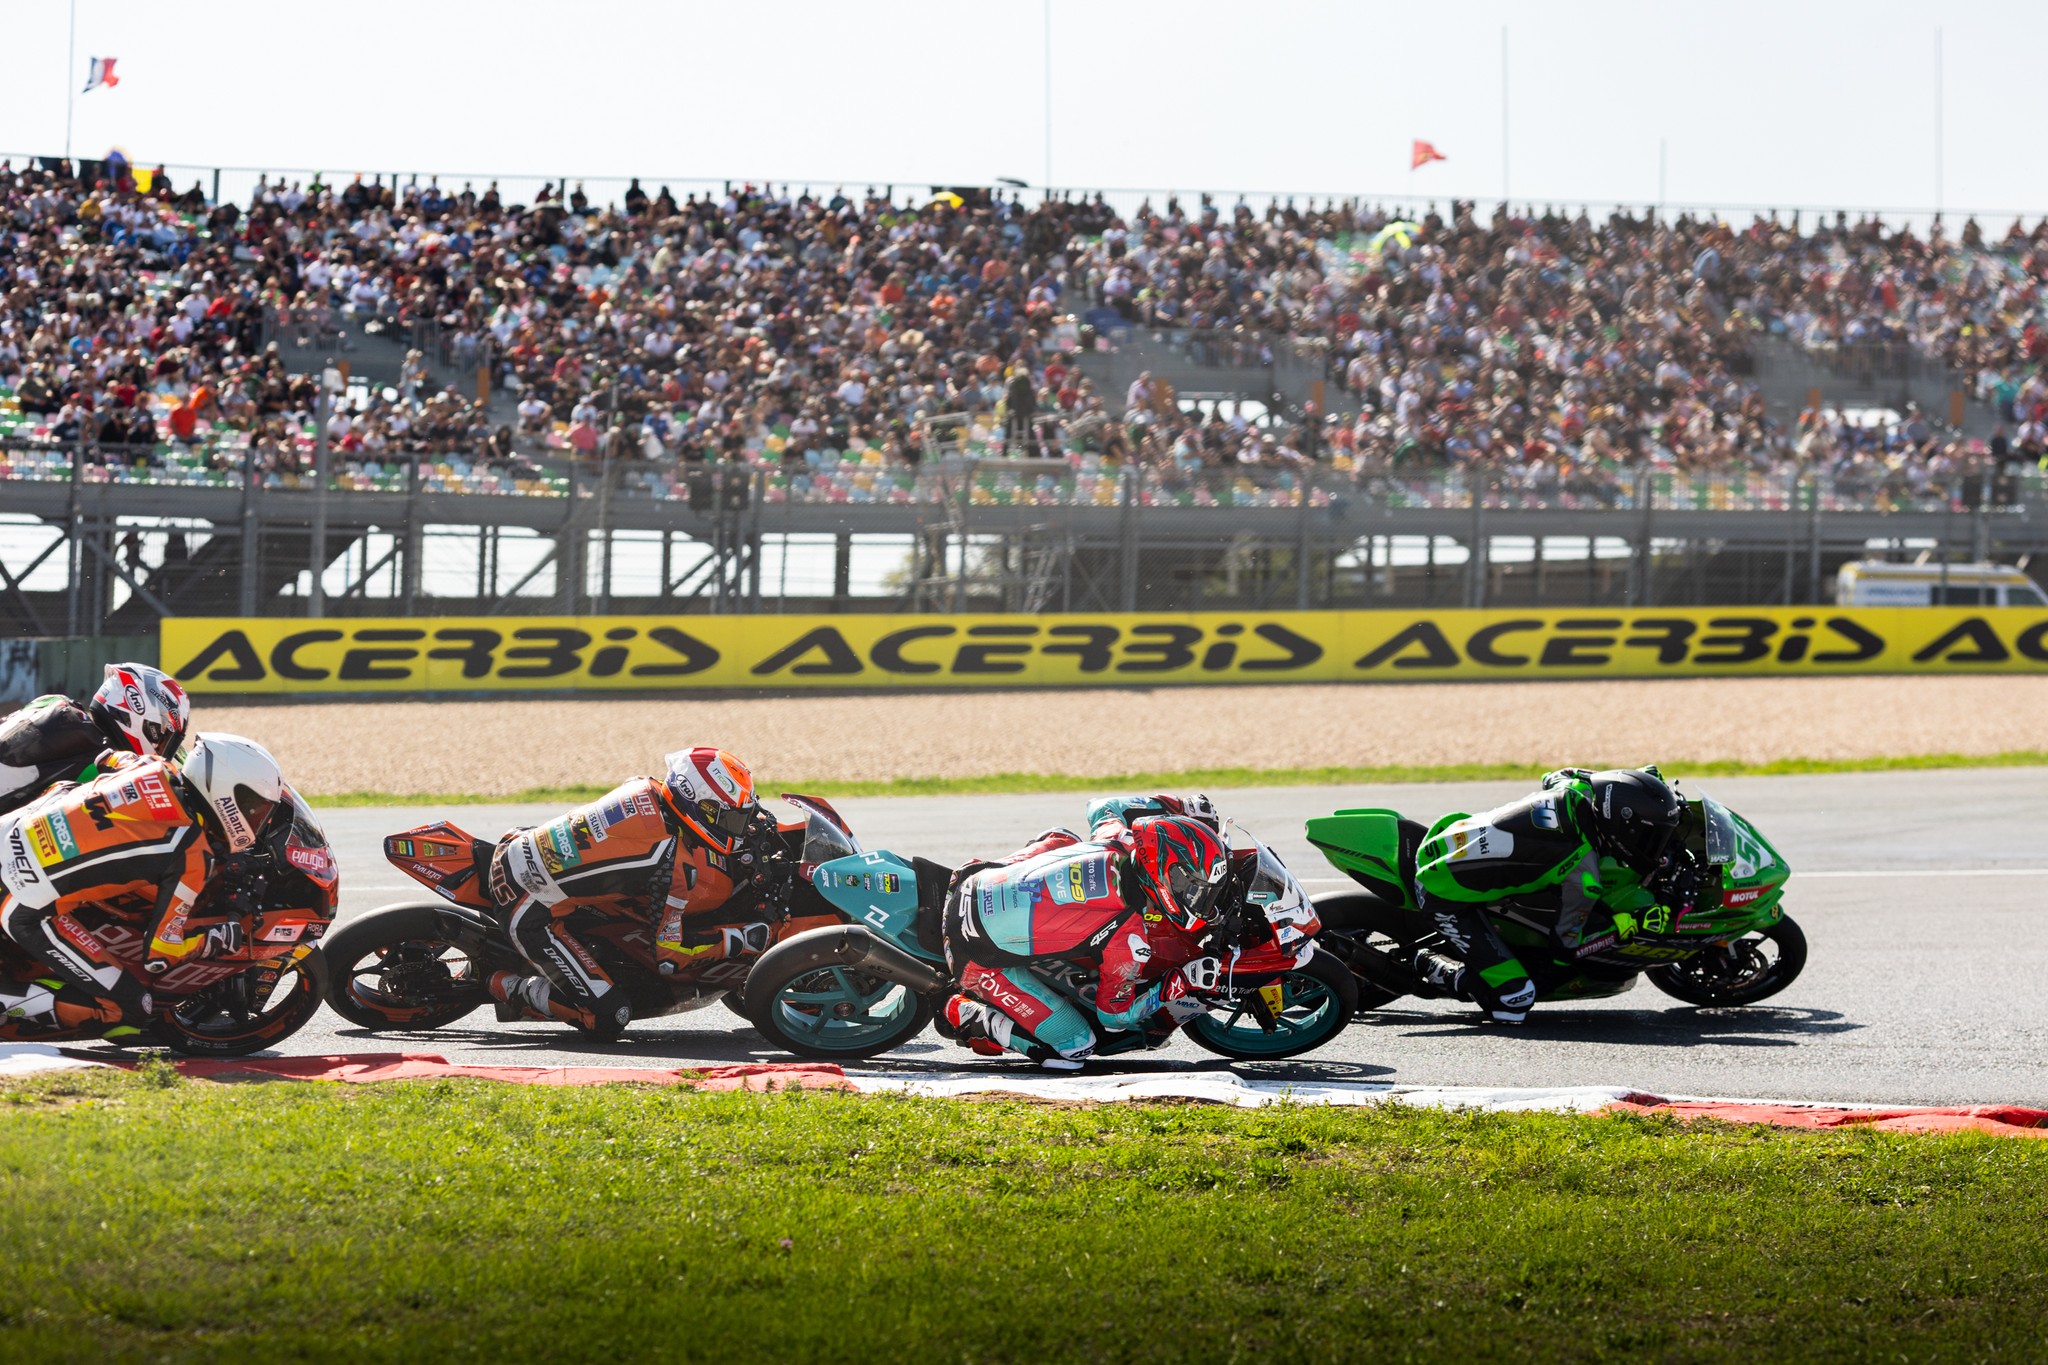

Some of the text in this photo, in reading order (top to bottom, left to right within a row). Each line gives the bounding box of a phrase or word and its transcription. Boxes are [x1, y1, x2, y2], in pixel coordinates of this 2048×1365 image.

[126, 686, 145, 712] Arai
[676, 776, 695, 799] Arai
[220, 796, 246, 835] Allianz
[1133, 829, 1150, 865] AIROH
[1557, 853, 1581, 877] 4SR
[1730, 890, 1759, 903] MOTUL
[1090, 920, 1118, 947] 4SR
[543, 948, 589, 997] DAMEN
